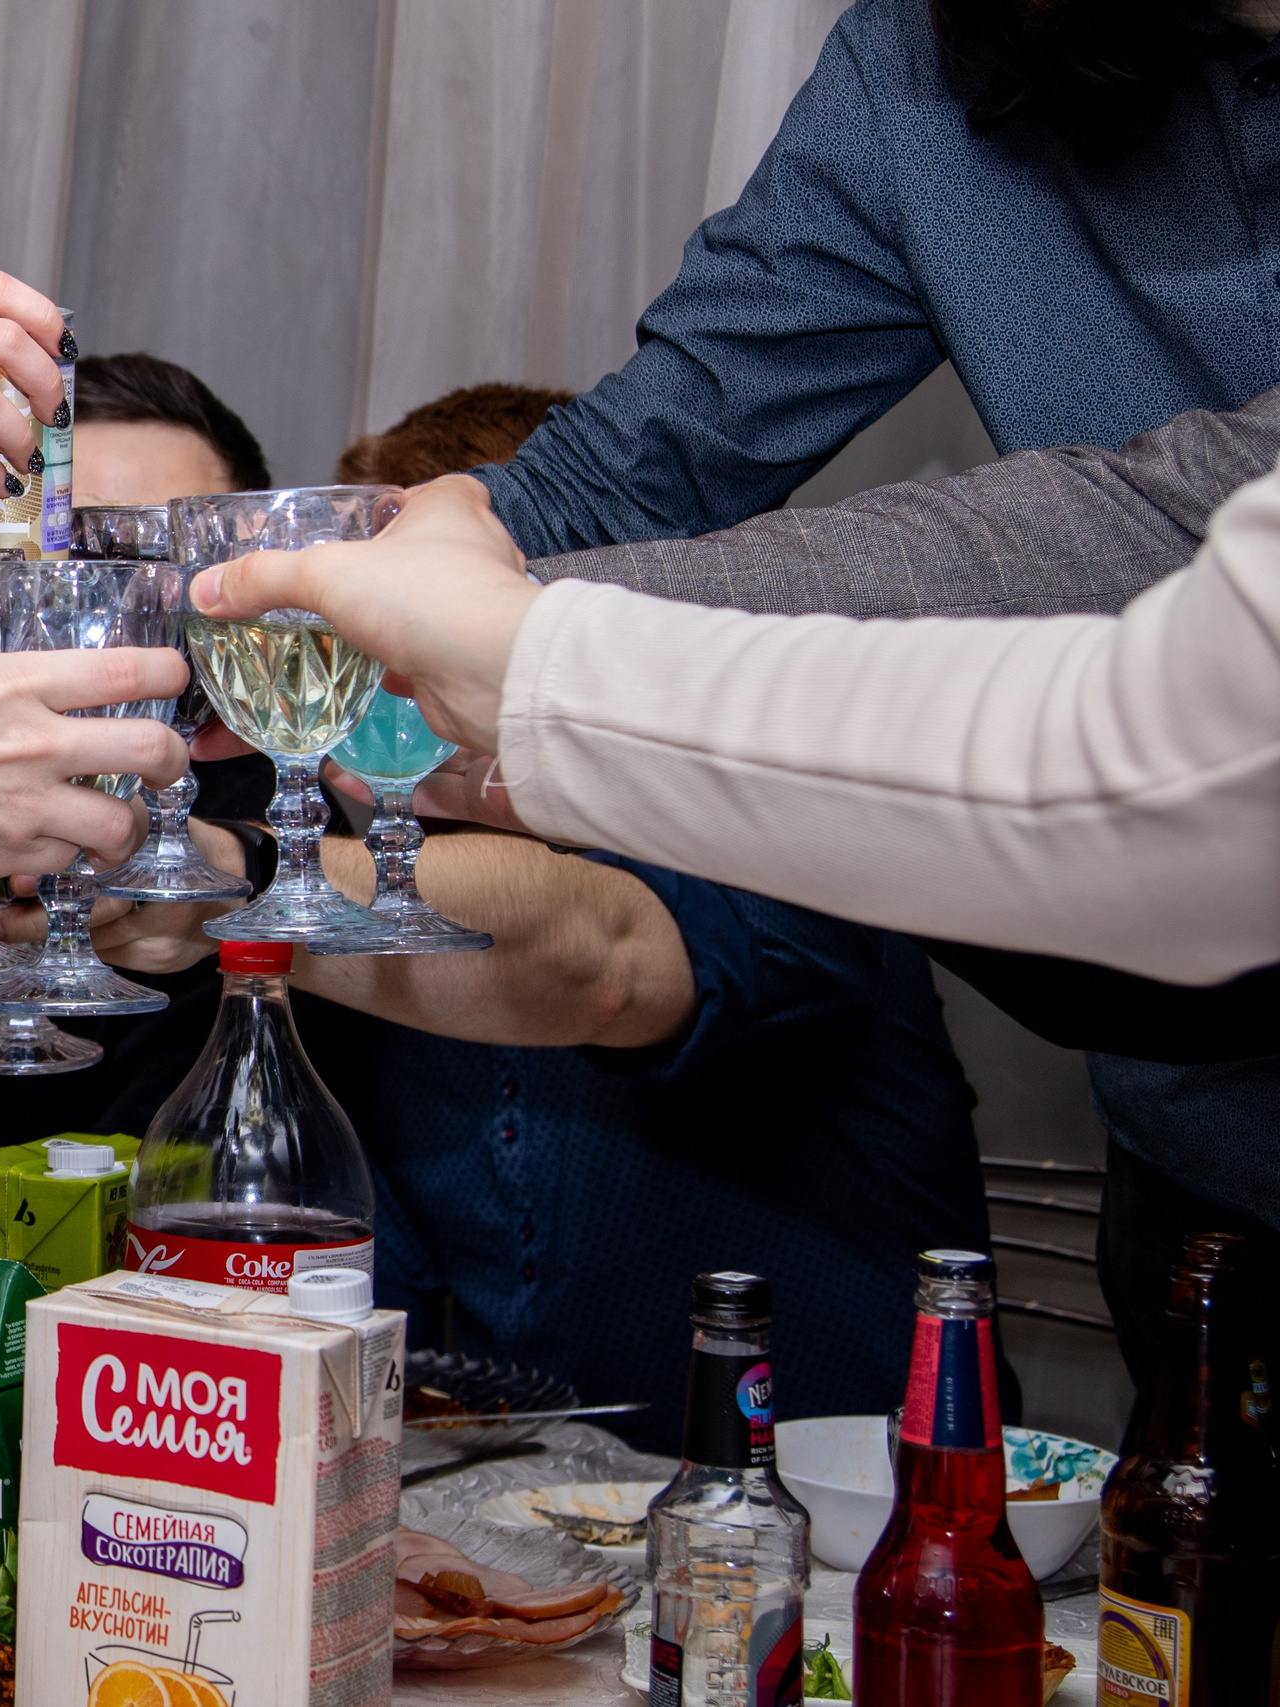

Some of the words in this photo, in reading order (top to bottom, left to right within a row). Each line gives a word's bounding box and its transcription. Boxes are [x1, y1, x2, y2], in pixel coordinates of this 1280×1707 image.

[225, 1252, 291, 1278] Coke
[238, 1278, 264, 1286] COCA-COLA
[137, 1361, 248, 1422] МОЯ
[81, 1353, 252, 1466] Семья
[750, 1447, 767, 1455] RICH
[751, 1456, 760, 1464] OF
[113, 1512, 215, 1545] СЕМЕЙНАЯ
[95, 1536, 230, 1583] СОКОТЕРАПИЯ
[76, 1583, 172, 1621] АПЕЛЬСИН-
[69, 1611, 170, 1648] ВКУСНОТИН
